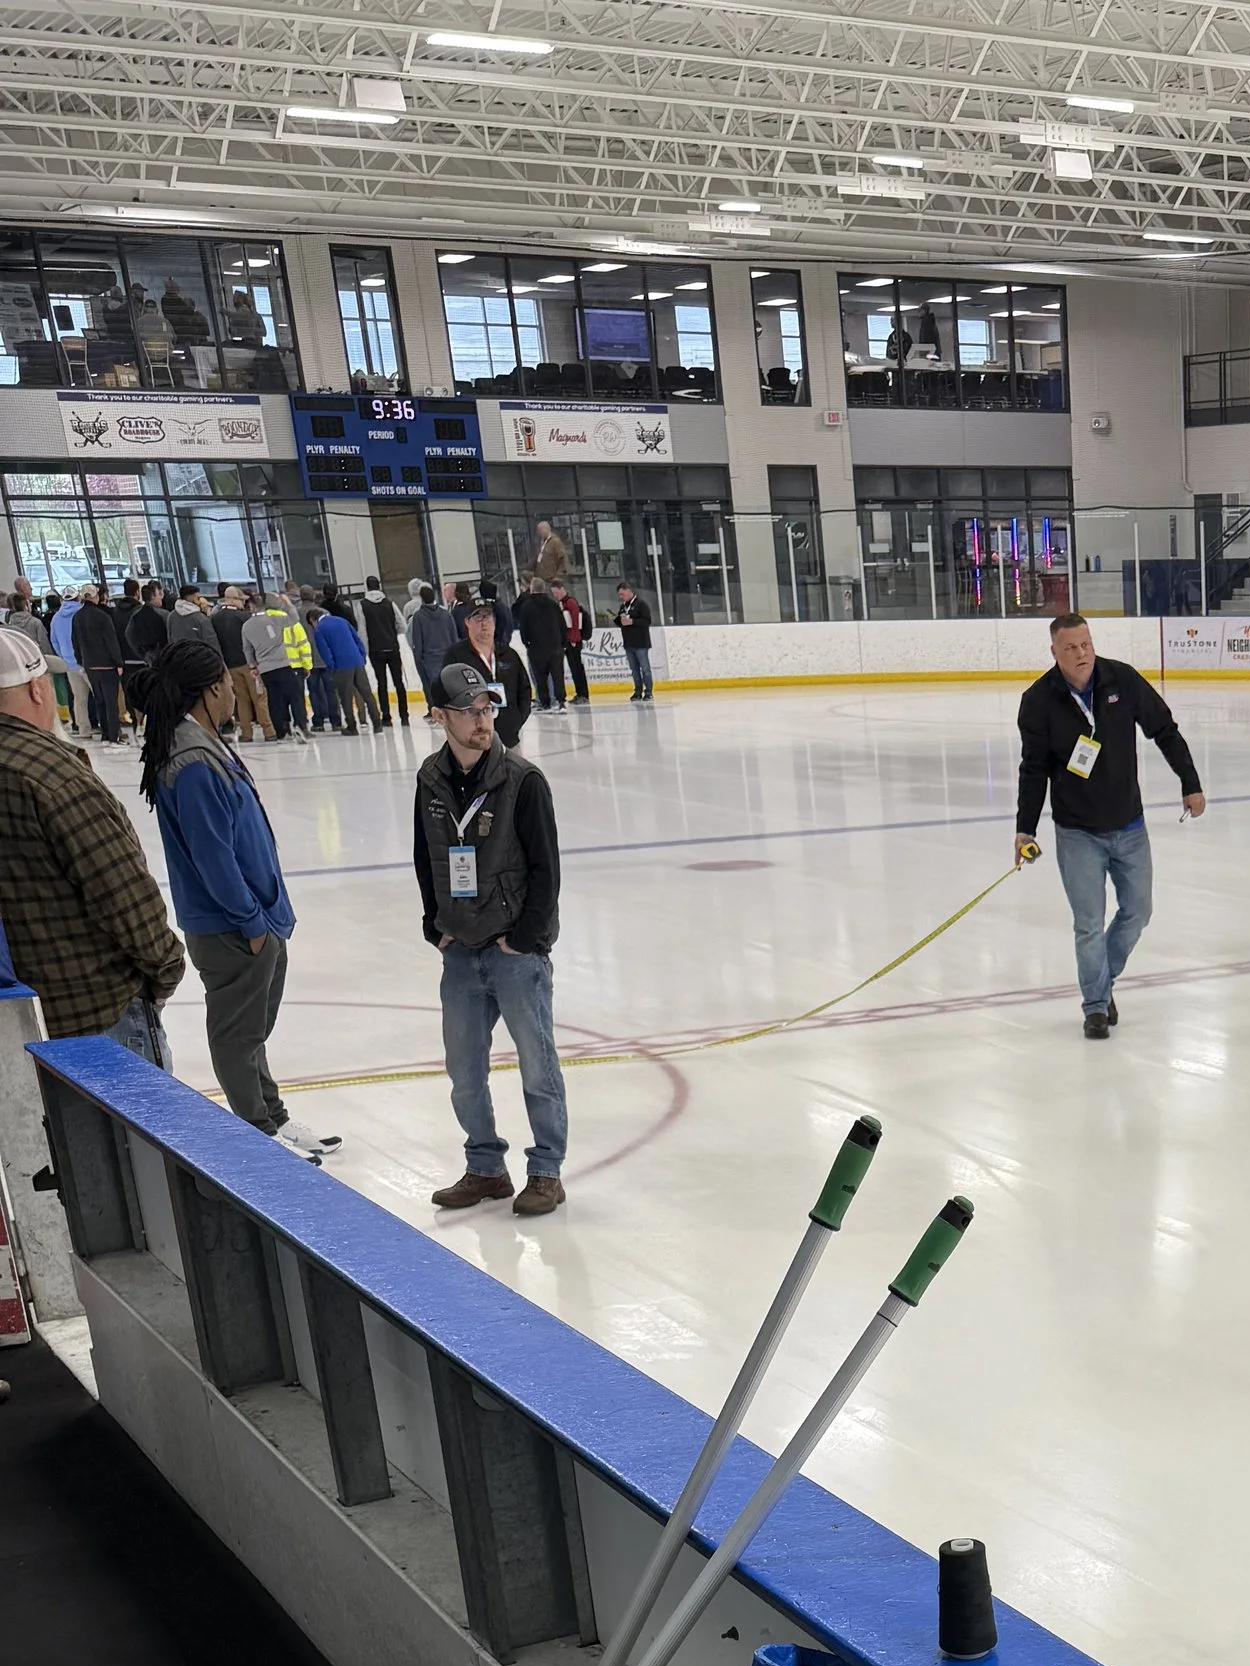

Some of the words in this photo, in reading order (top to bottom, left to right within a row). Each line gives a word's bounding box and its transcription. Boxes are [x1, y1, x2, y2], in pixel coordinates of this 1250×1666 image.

[179, 396, 203, 404] gaming
[372, 400, 415, 420] 9:36
[368, 430, 394, 440] PERIOD
[306, 445, 324, 453] PLYR
[329, 445, 360, 454] PENALTY
[425, 447, 442, 455] PLYR
[447, 447, 476, 456] PENALTY
[371, 486, 394, 495] SHOTS
[396, 487, 406, 495] ON
[408, 487, 426, 495] GOAL
[1168, 640, 1217, 648] TRUSTONE
